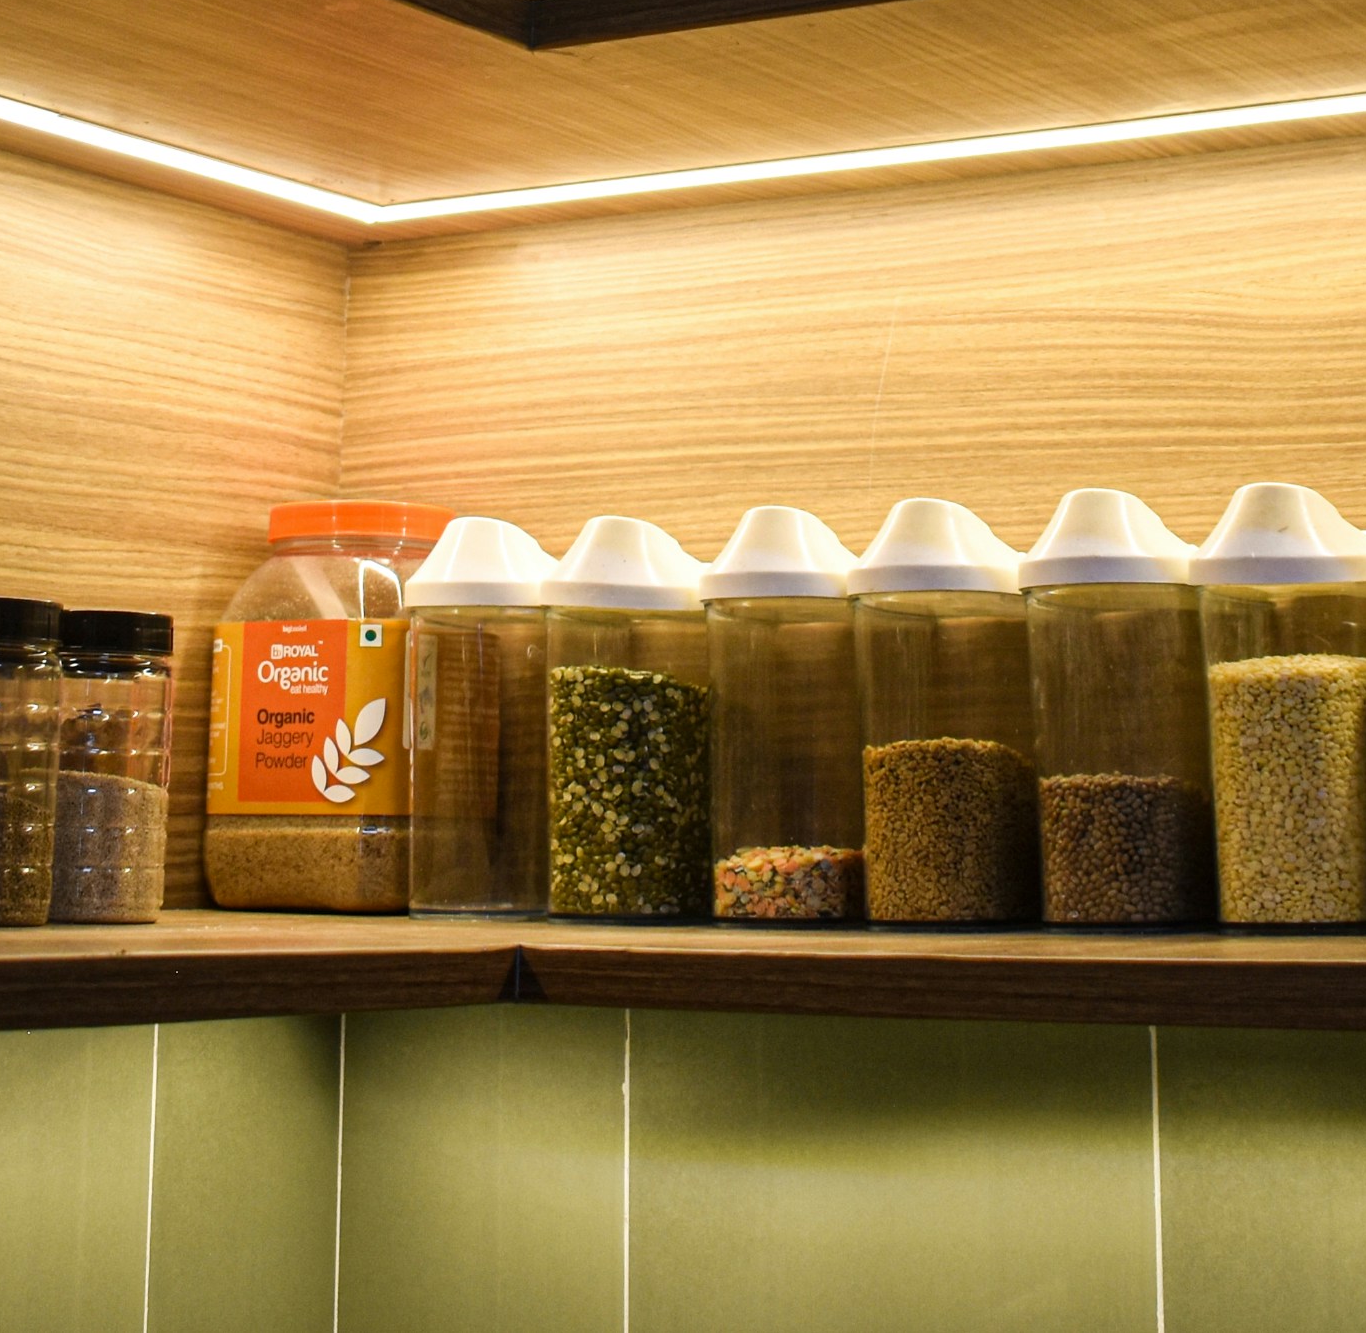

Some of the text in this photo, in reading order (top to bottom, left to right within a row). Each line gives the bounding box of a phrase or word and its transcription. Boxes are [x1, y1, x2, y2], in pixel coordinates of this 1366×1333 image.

[283, 644, 319, 658] ROYAL
[257, 660, 329, 690] Organic
[290, 682, 329, 696] eat healthy
[256, 708, 315, 730] Organic
[256, 729, 314, 748] Jaggery
[254, 751, 308, 769] Powder
